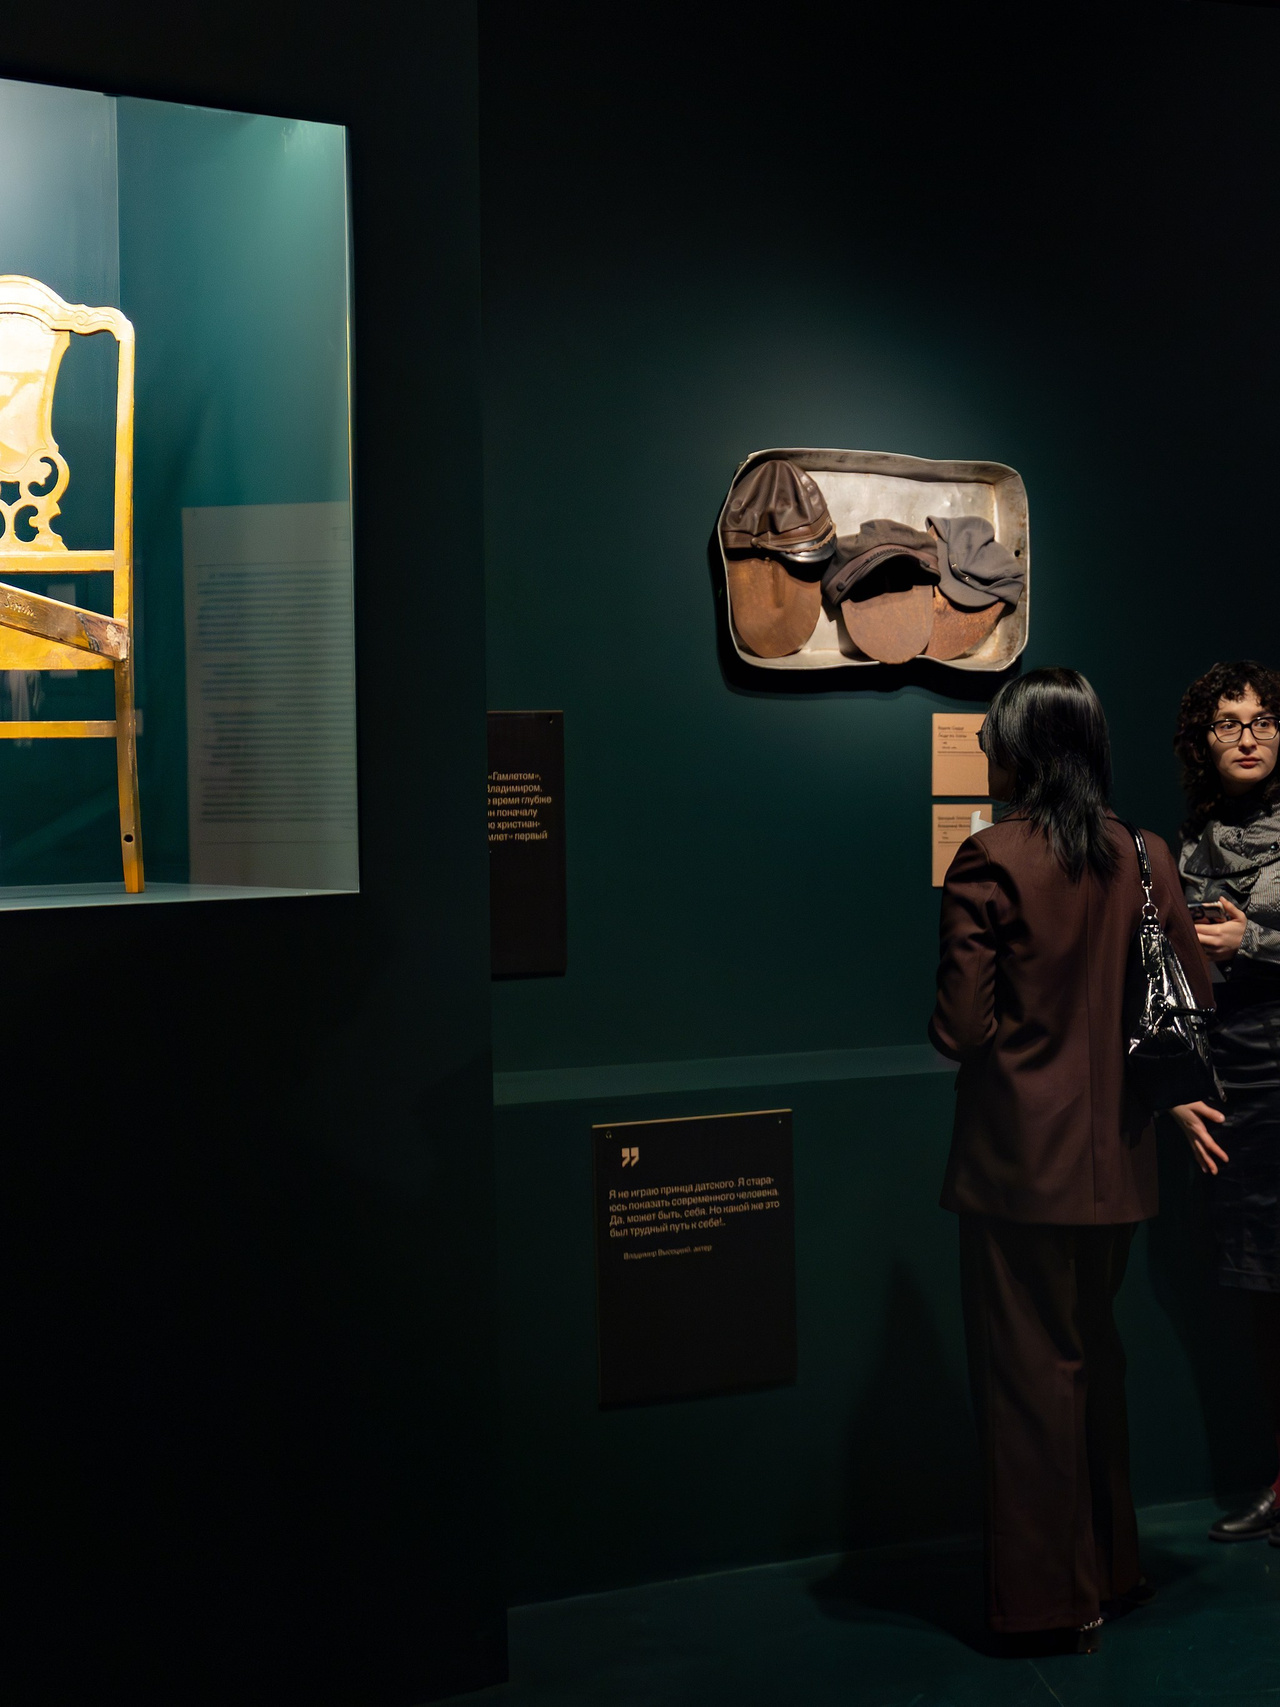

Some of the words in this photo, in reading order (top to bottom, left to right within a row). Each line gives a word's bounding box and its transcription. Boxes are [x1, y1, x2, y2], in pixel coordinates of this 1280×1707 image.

[492, 796, 520, 807] время
[521, 795, 552, 806] глубже
[496, 808, 538, 819] поначалу
[496, 820, 541, 831] христиан-
[514, 830, 548, 842] первый
